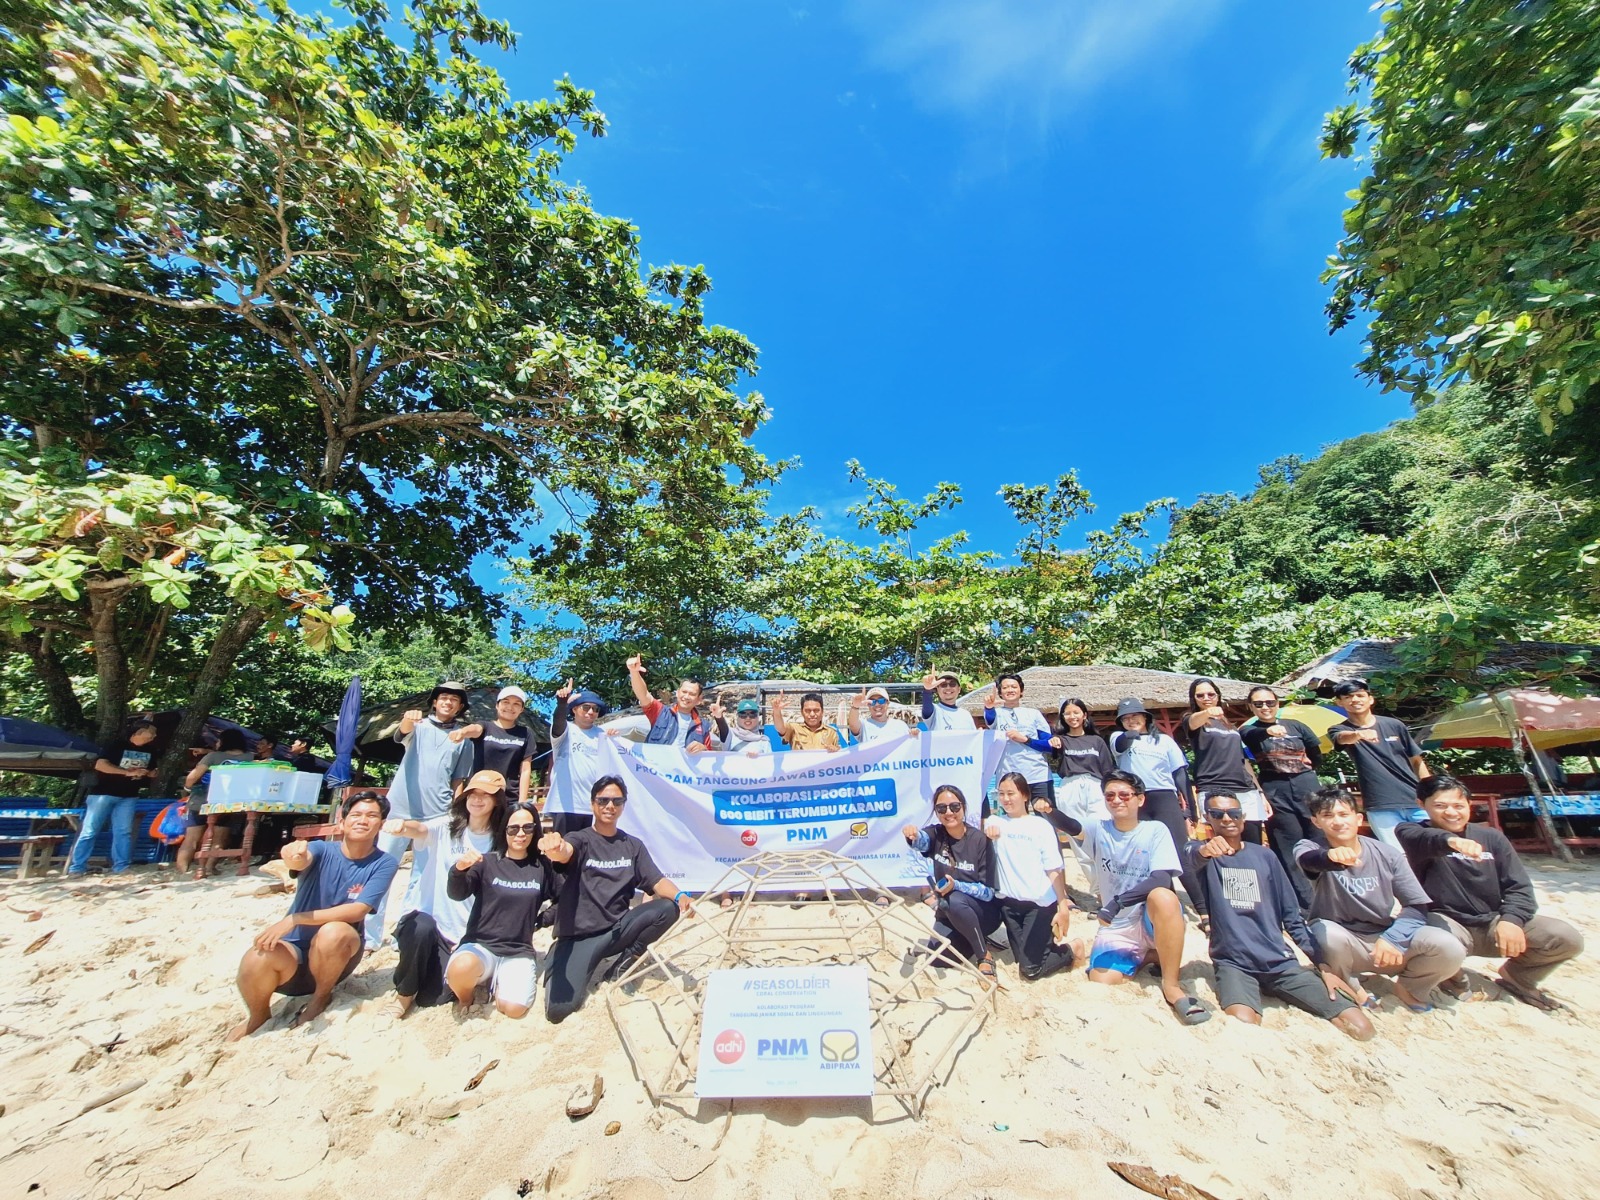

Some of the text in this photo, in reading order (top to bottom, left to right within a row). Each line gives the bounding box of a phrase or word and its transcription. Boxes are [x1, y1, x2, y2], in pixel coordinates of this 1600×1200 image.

[770, 769, 816, 783] JAWAB
[818, 765, 861, 778] SOSIAL
[863, 762, 890, 773] DAN
[893, 755, 974, 771] LINGKUNGAN
[730, 785, 877, 806] KOLABORASI PROGRAM
[744, 808, 776, 821] BIBIT
[777, 804, 838, 820] TERUMBU
[838, 800, 893, 815] KARANG
[786, 827, 828, 842] PNM
[1335, 874, 1380, 896] OUSEN
[716, 1040, 743, 1053] adhi
[757, 1038, 808, 1056] PNM
[820, 1062, 860, 1070] ABIPRAYA
